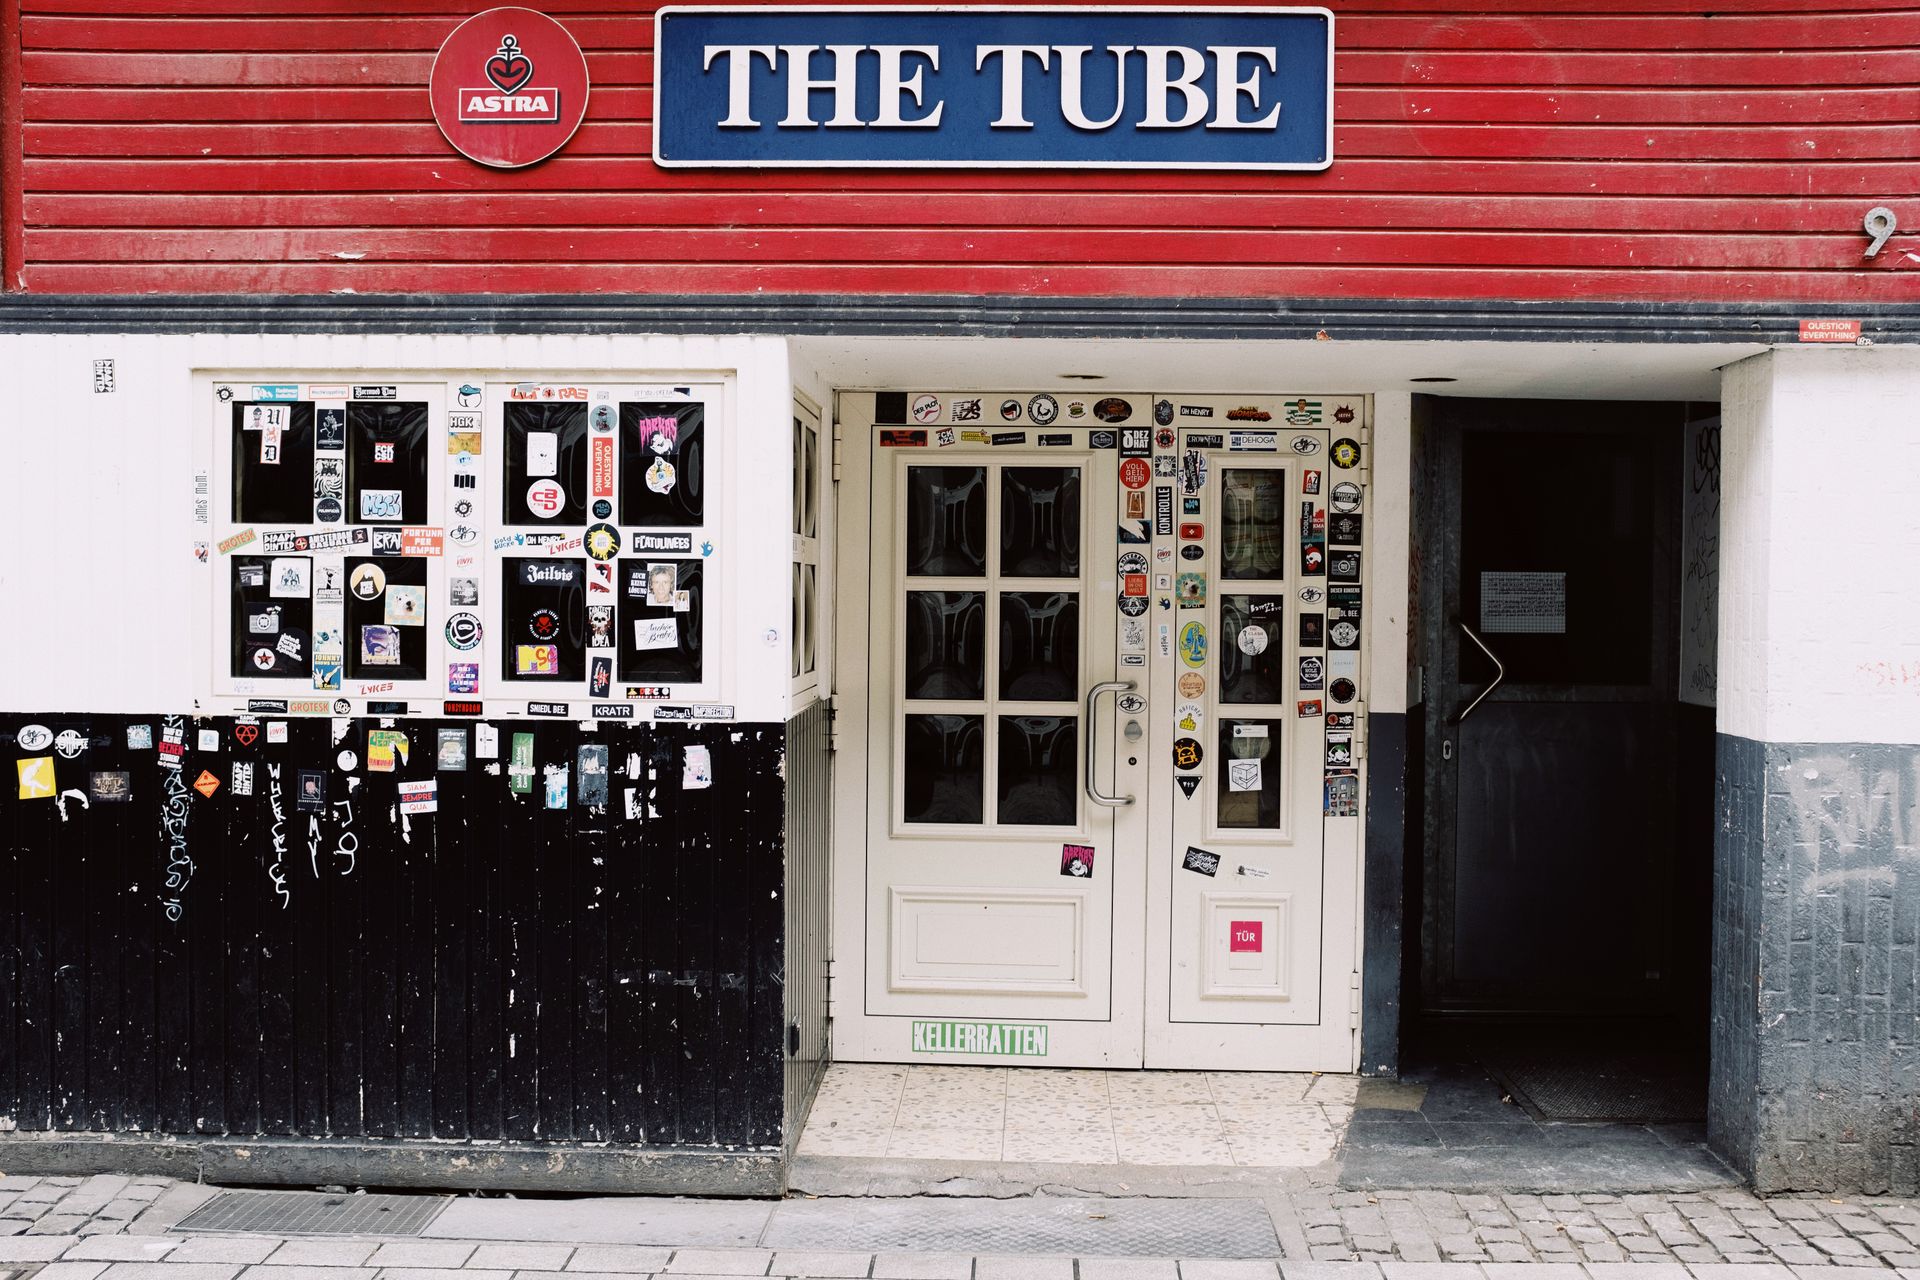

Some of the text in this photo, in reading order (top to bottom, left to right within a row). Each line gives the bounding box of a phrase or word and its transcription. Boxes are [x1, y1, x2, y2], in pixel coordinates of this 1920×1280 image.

[704, 45, 1281, 129] THE TUBE
[467, 96, 549, 112] ASTRA
[1864, 207, 1897, 257] 9
[1808, 322, 1851, 330] QUESTION
[1803, 331, 1856, 339] EVERYTHING
[1190, 408, 1209, 416] HENRY
[450, 416, 473, 428] HGK
[1134, 431, 1149, 439] DEZ
[1242, 436, 1275, 444] DEHOGA
[1134, 440, 1149, 448] HAT
[1159, 488, 1170, 534] KONTROLLE
[404, 529, 443, 537] FORTUNA
[219, 530, 256, 553] GROTESK
[592, 636, 609, 647] IDEA
[361, 682, 394, 695] LYKES
[290, 703, 329, 713] GROTESK
[595, 707, 630, 715] KRATR
[402, 793, 432, 802] SEMPRE
[1236, 931, 1255, 942] TÜR
[914, 1023, 1047, 1055] KELLERRATTEN
